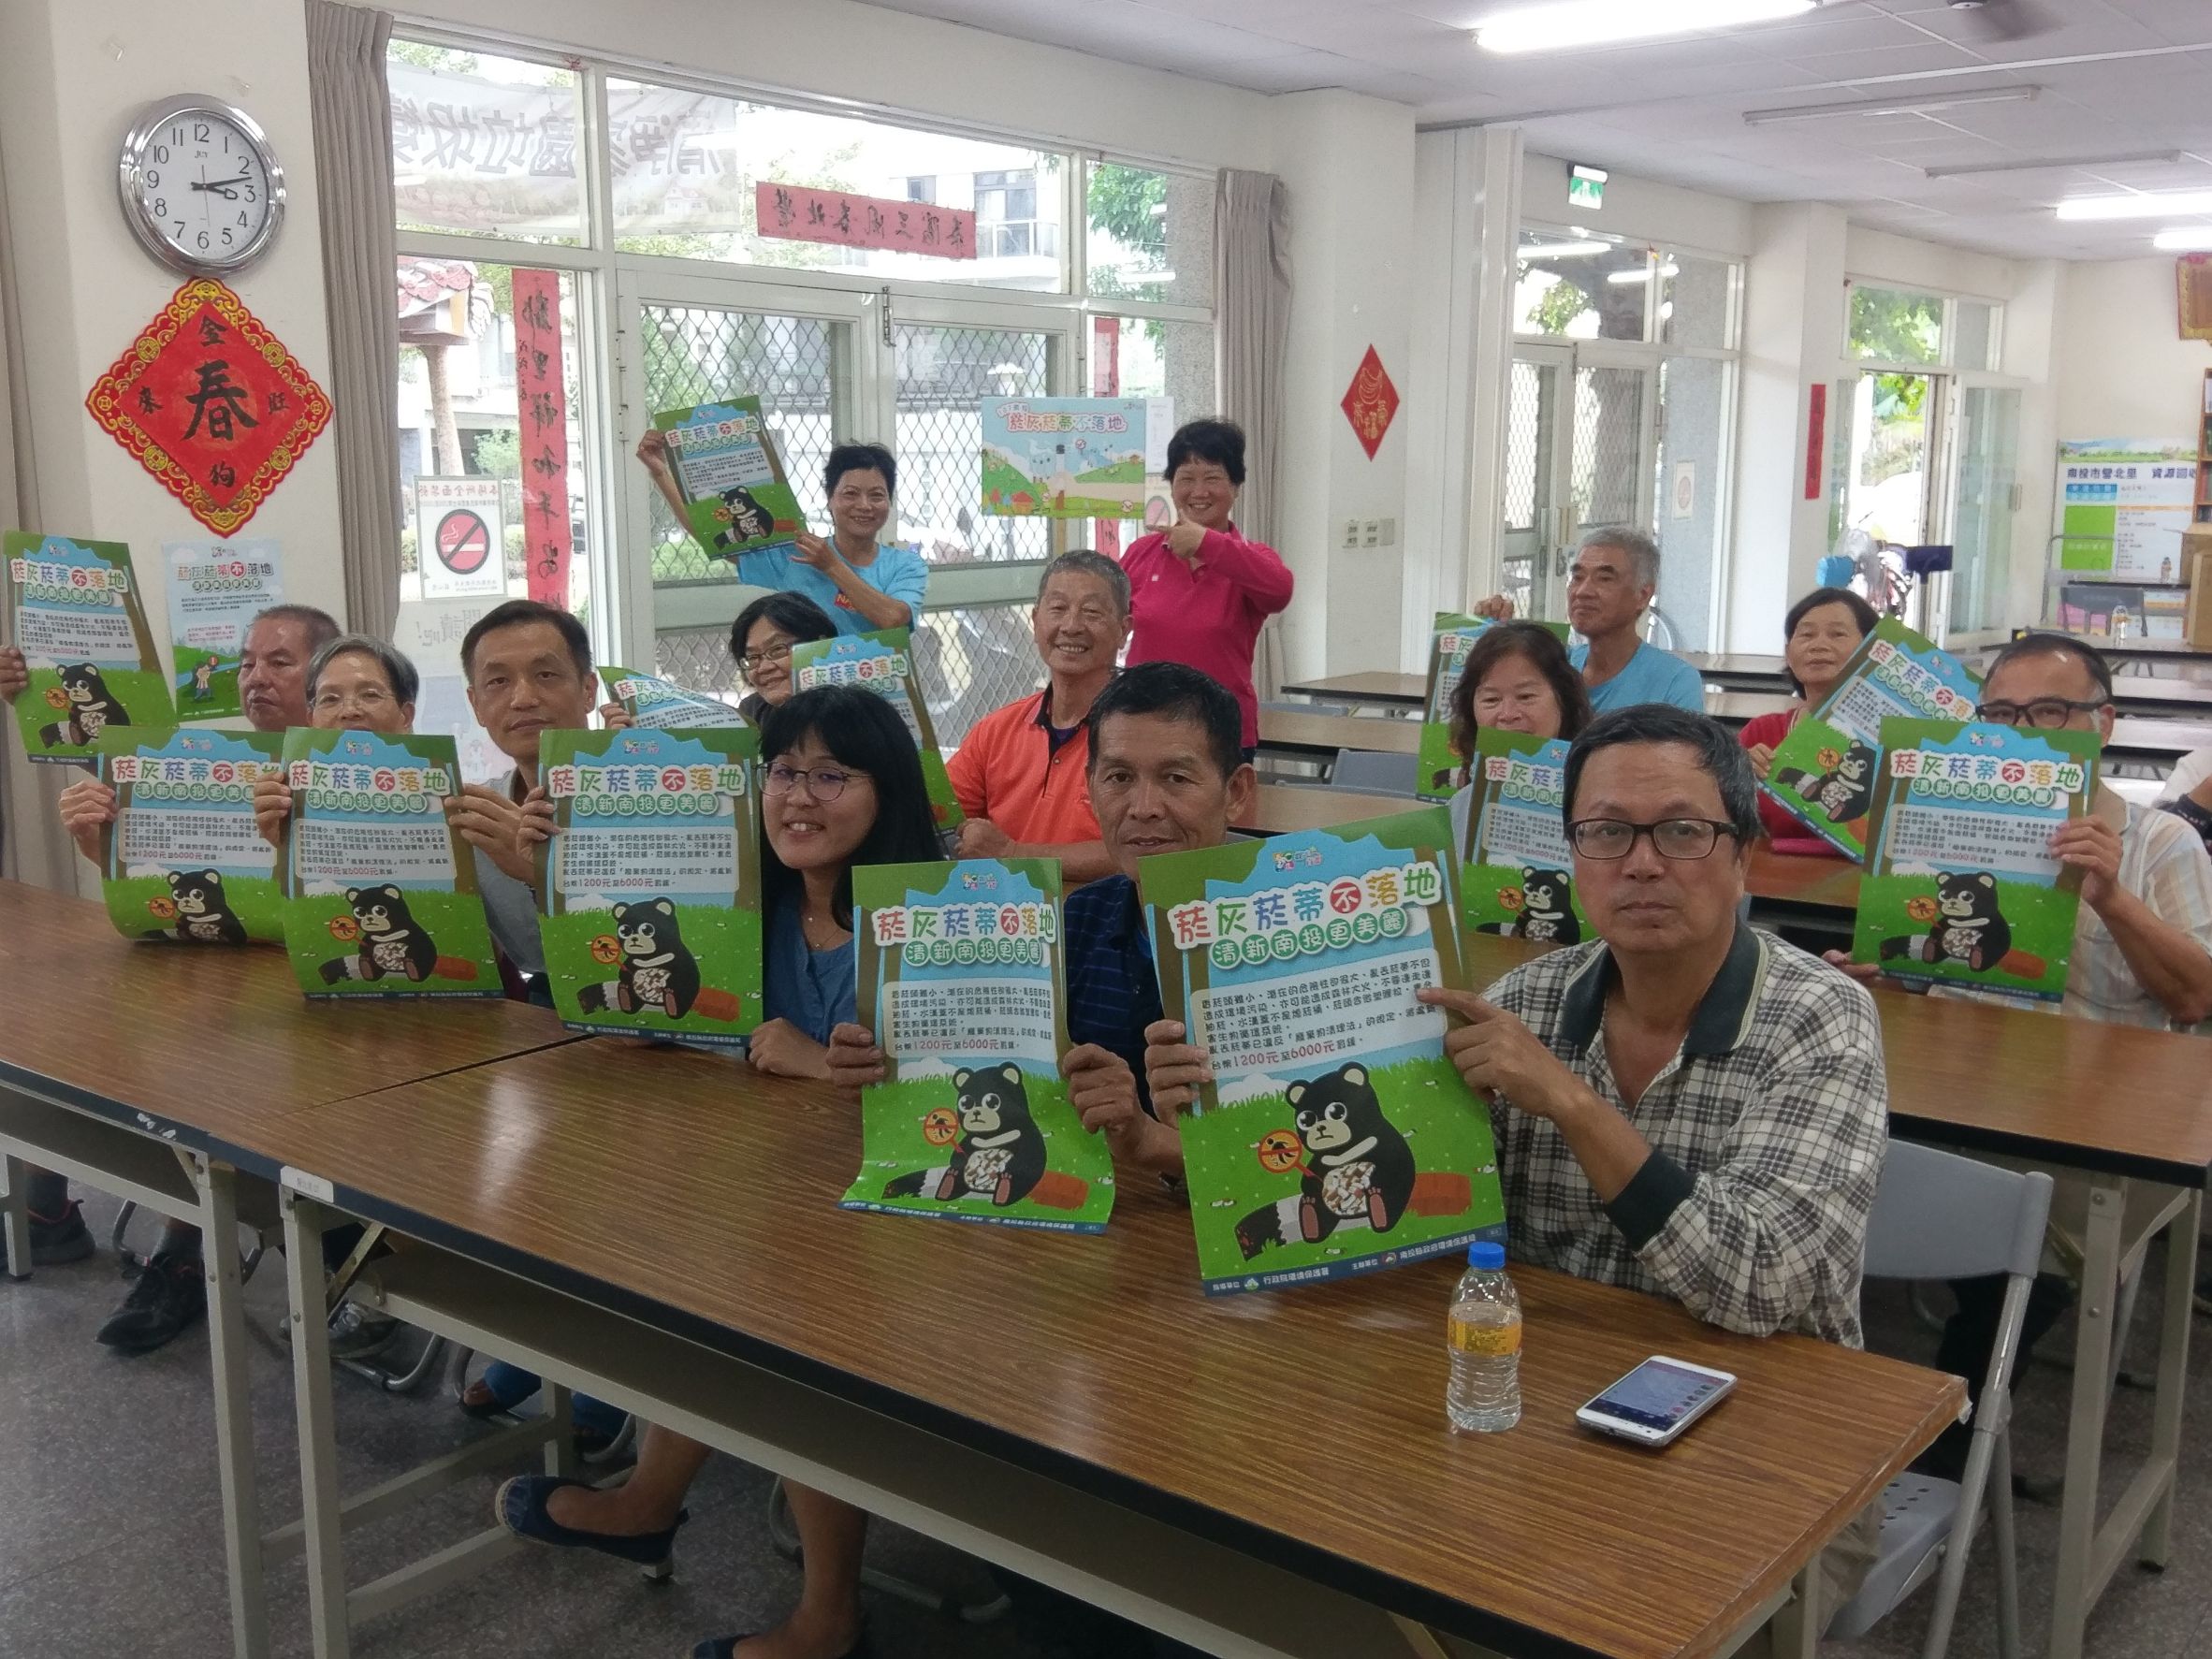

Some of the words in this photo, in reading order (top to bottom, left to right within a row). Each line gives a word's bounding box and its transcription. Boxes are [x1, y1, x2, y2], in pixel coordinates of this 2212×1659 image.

[173, 127, 183, 146] 11
[194, 123, 210, 142] 12
[153, 145, 169, 163] 10
[239, 156, 251, 174] 2
[147, 170, 159, 188] 9
[244, 184, 255, 203] 3
[154, 198, 167, 217] 8
[237, 211, 248, 228] 4
[174, 222, 185, 239] 7
[221, 227, 233, 245] 5
[197, 231, 209, 250] 6
[197, 314, 227, 346] 全
[181, 359, 260, 441] 春
[1871, 643, 1977, 720] 菸灰菸蒂不落
[292, 764, 446, 791] 菸灰菸蒂不落地
[1894, 751, 2081, 788] 菸灰菸蒂不落地
[552, 767, 741, 793] 菸灰菸蒂不落地
[1173, 866, 1435, 944] 菸灰菸蒂不落地
[877, 902, 1055, 939] 菸灰菸蒂不落地
[1214, 909, 1404, 965] 清新南投更美麗
